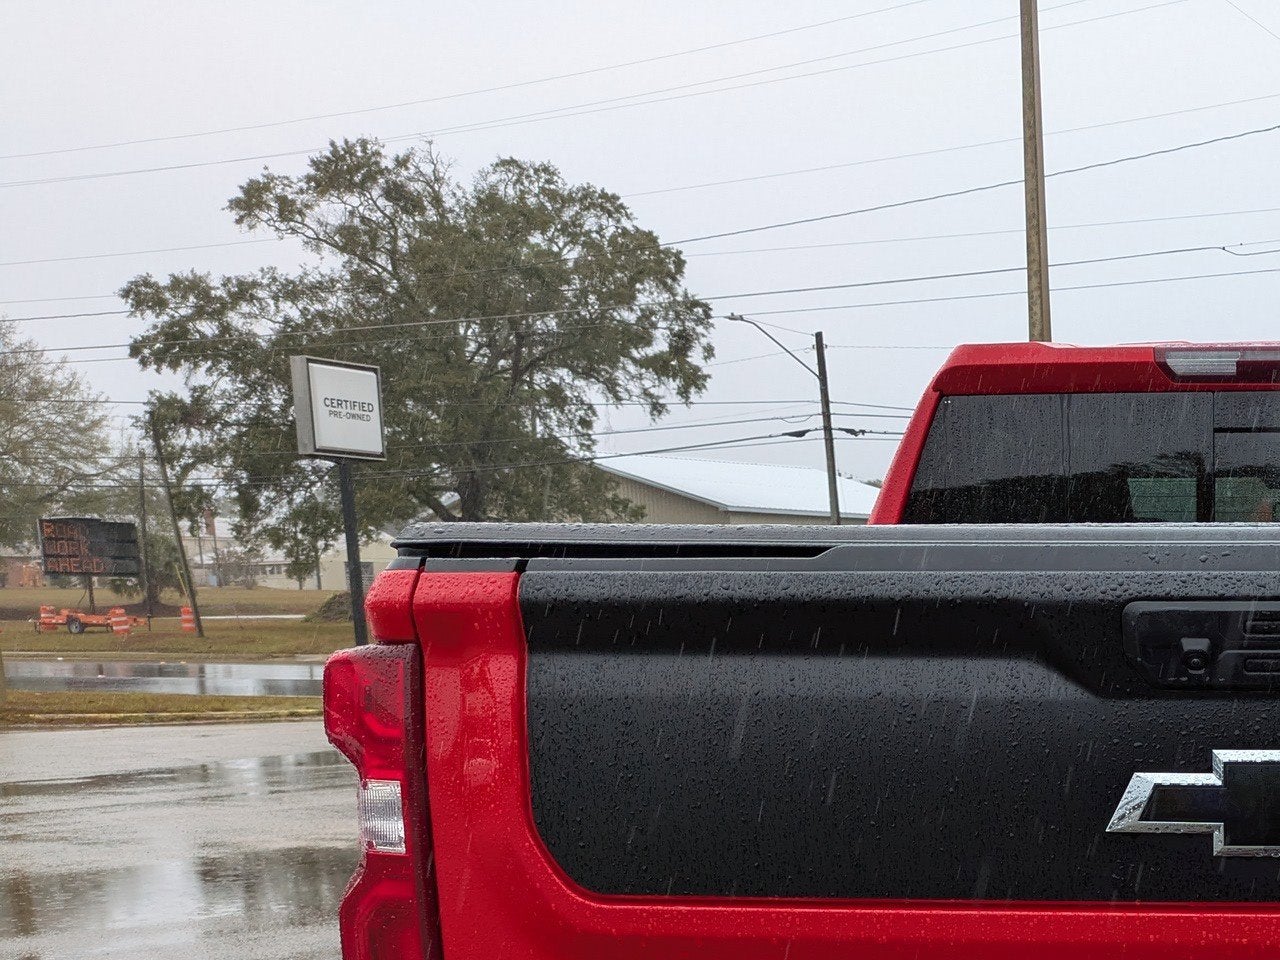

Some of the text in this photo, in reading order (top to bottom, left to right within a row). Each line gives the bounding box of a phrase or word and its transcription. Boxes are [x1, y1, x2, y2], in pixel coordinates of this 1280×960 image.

[323, 397, 375, 413] CERTIFIED
[328, 410, 372, 422] PRE-OWNED
[46, 557, 106, 573] AHEAD
